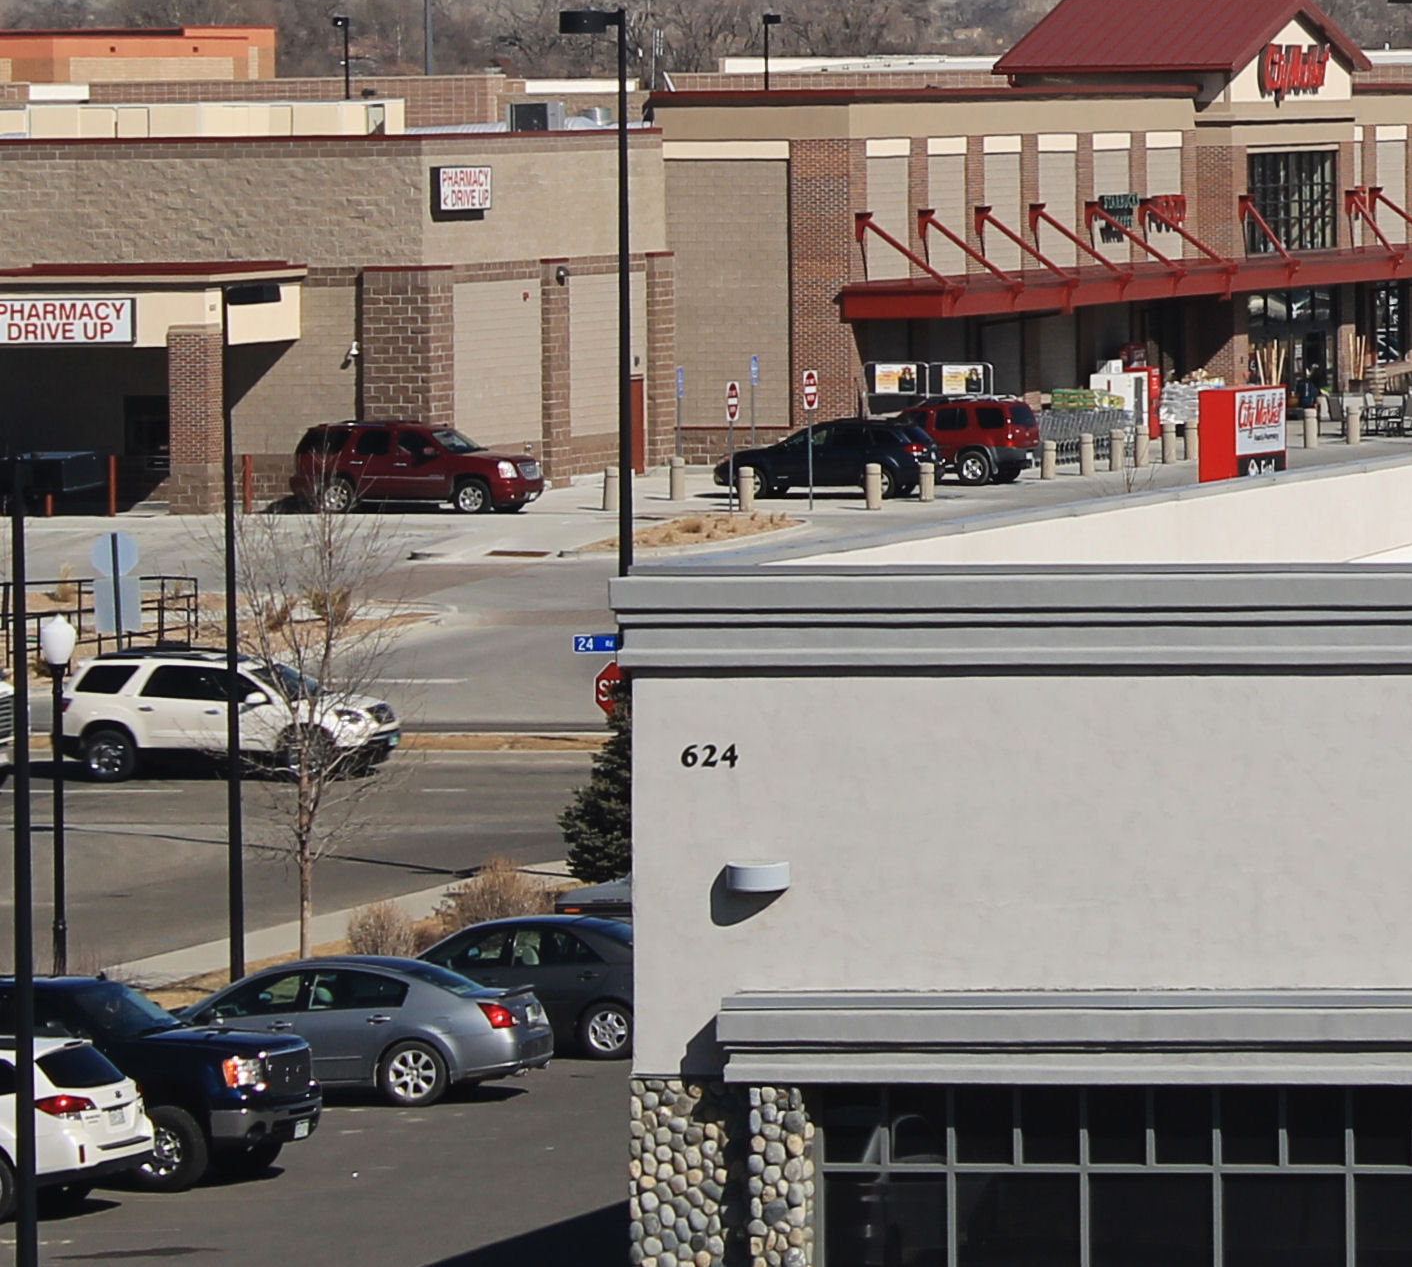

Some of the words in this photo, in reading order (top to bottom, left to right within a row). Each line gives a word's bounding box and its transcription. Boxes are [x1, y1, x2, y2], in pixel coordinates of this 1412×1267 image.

[443, 170, 489, 187] PHARMACY
[452, 189, 476, 207] DRIVE
[478, 189, 488, 206] UP
[0, 302, 125, 321] PHARMACY
[7, 323, 75, 341] DRIVE
[82, 322, 114, 340] UP
[577, 637, 594, 651] 24
[681, 743, 738, 769] 624
